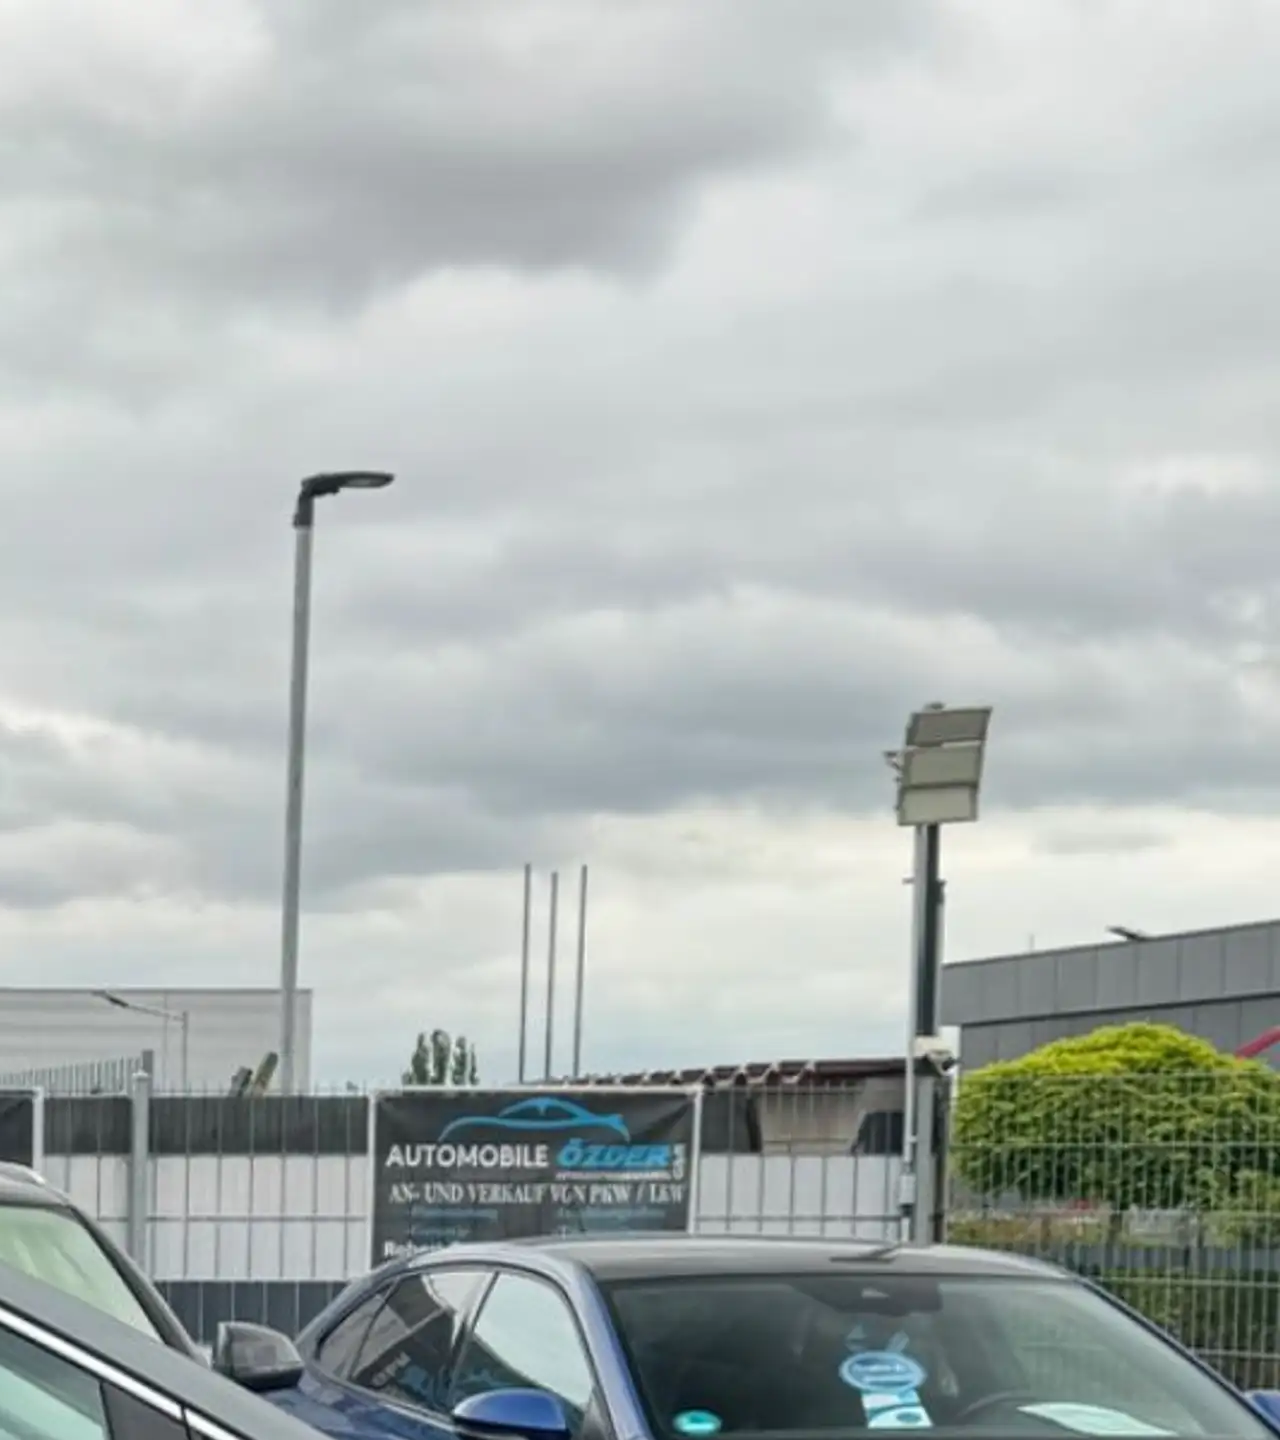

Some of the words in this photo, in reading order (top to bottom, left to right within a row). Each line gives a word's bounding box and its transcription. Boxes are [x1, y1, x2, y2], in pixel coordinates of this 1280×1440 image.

[385, 1143, 549, 1168] AUTOMOBILE
[557, 1138, 671, 1168] ÖZDER
[424, 1182, 464, 1204] UND
[467, 1182, 545, 1204] VERKAUF
[590, 1183, 632, 1204] PKW
[650, 1183, 687, 1204] LKW
